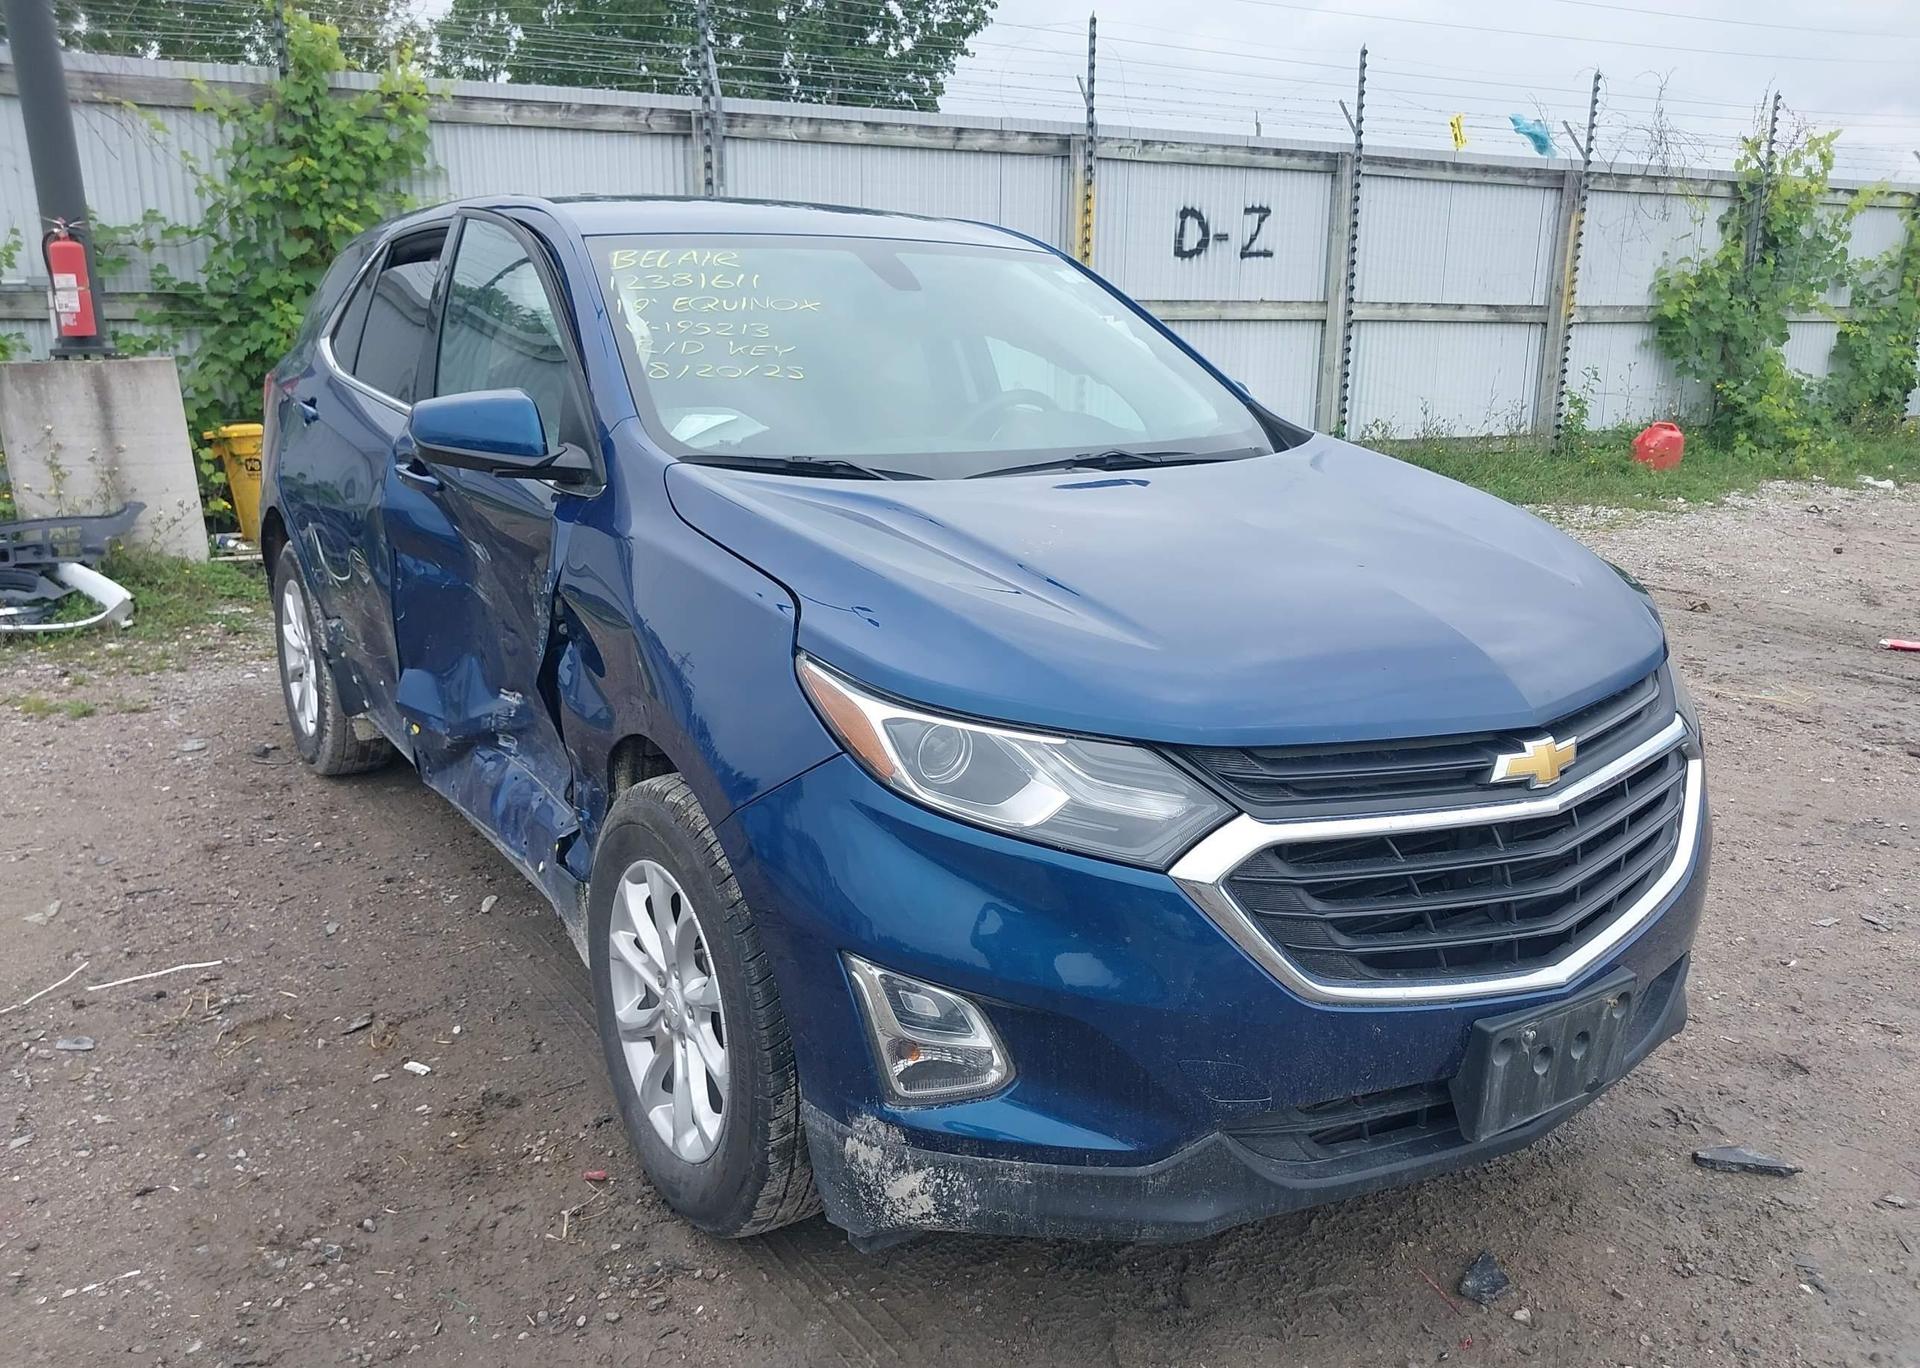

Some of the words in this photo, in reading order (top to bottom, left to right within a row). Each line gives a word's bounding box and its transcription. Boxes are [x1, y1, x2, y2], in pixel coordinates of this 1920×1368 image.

[1174, 205, 1273, 259] D-Z
[610, 272, 759, 290] 12381611
[672, 296, 821, 312] EQUINOX
[728, 341, 796, 357] KEY
[648, 362, 805, 379] 8/20/25
